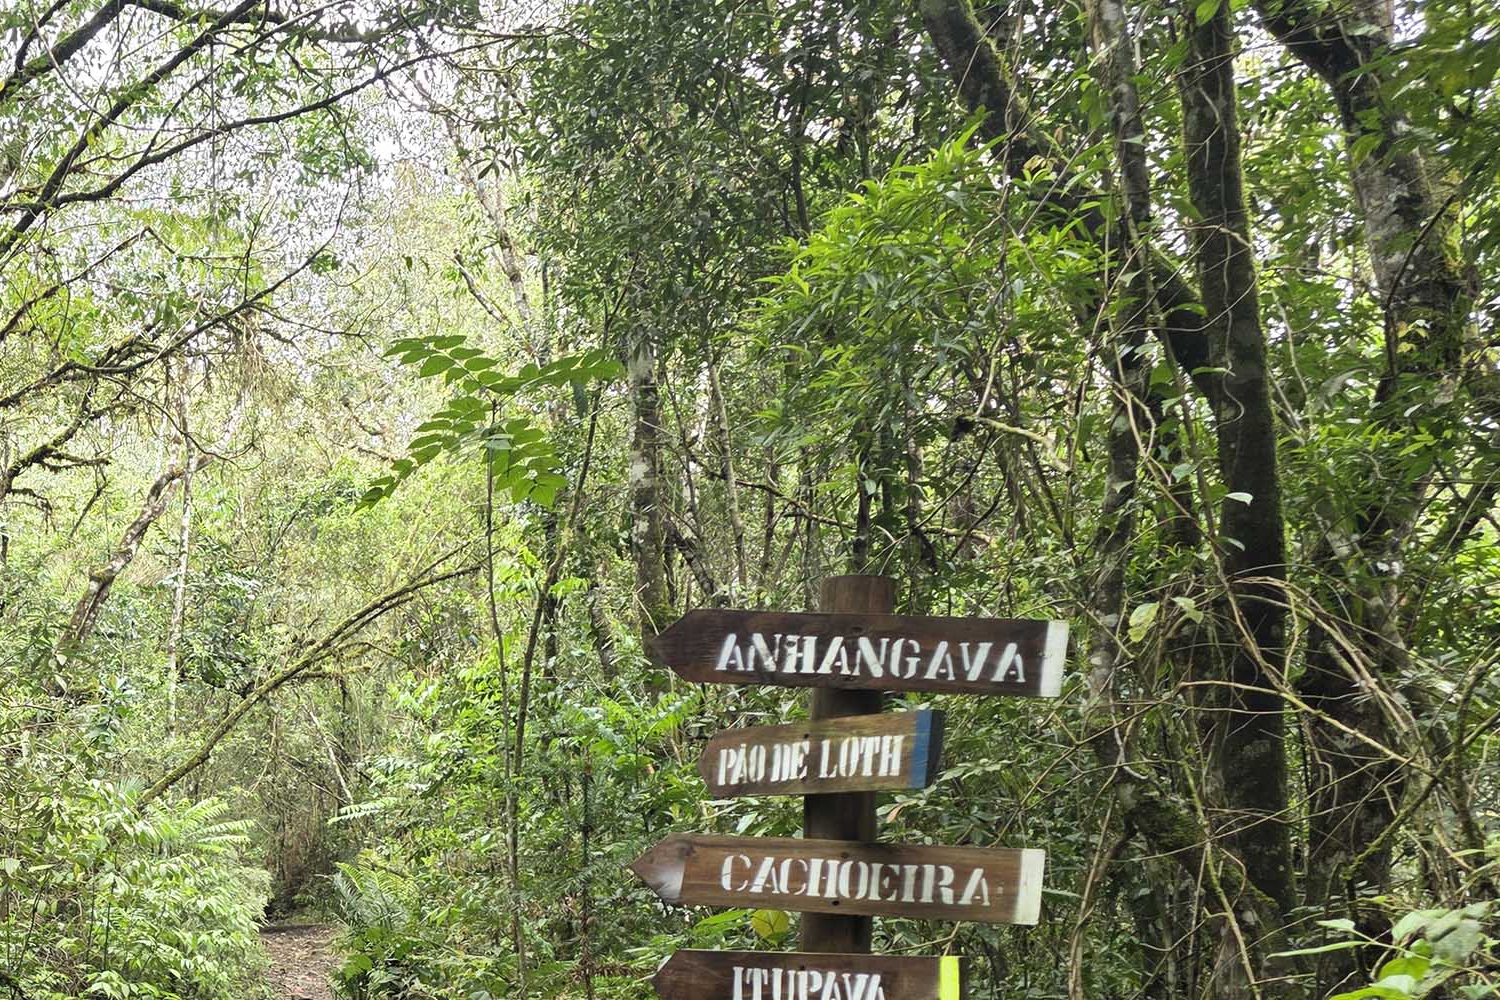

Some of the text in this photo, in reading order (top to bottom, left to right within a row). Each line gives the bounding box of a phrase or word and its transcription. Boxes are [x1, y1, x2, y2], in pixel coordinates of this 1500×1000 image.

[715, 633, 1026, 683] ANHANGAVA
[770, 740, 810, 782] DE
[819, 735, 905, 778] LOTH
[721, 854, 991, 906] CACHOEIRA
